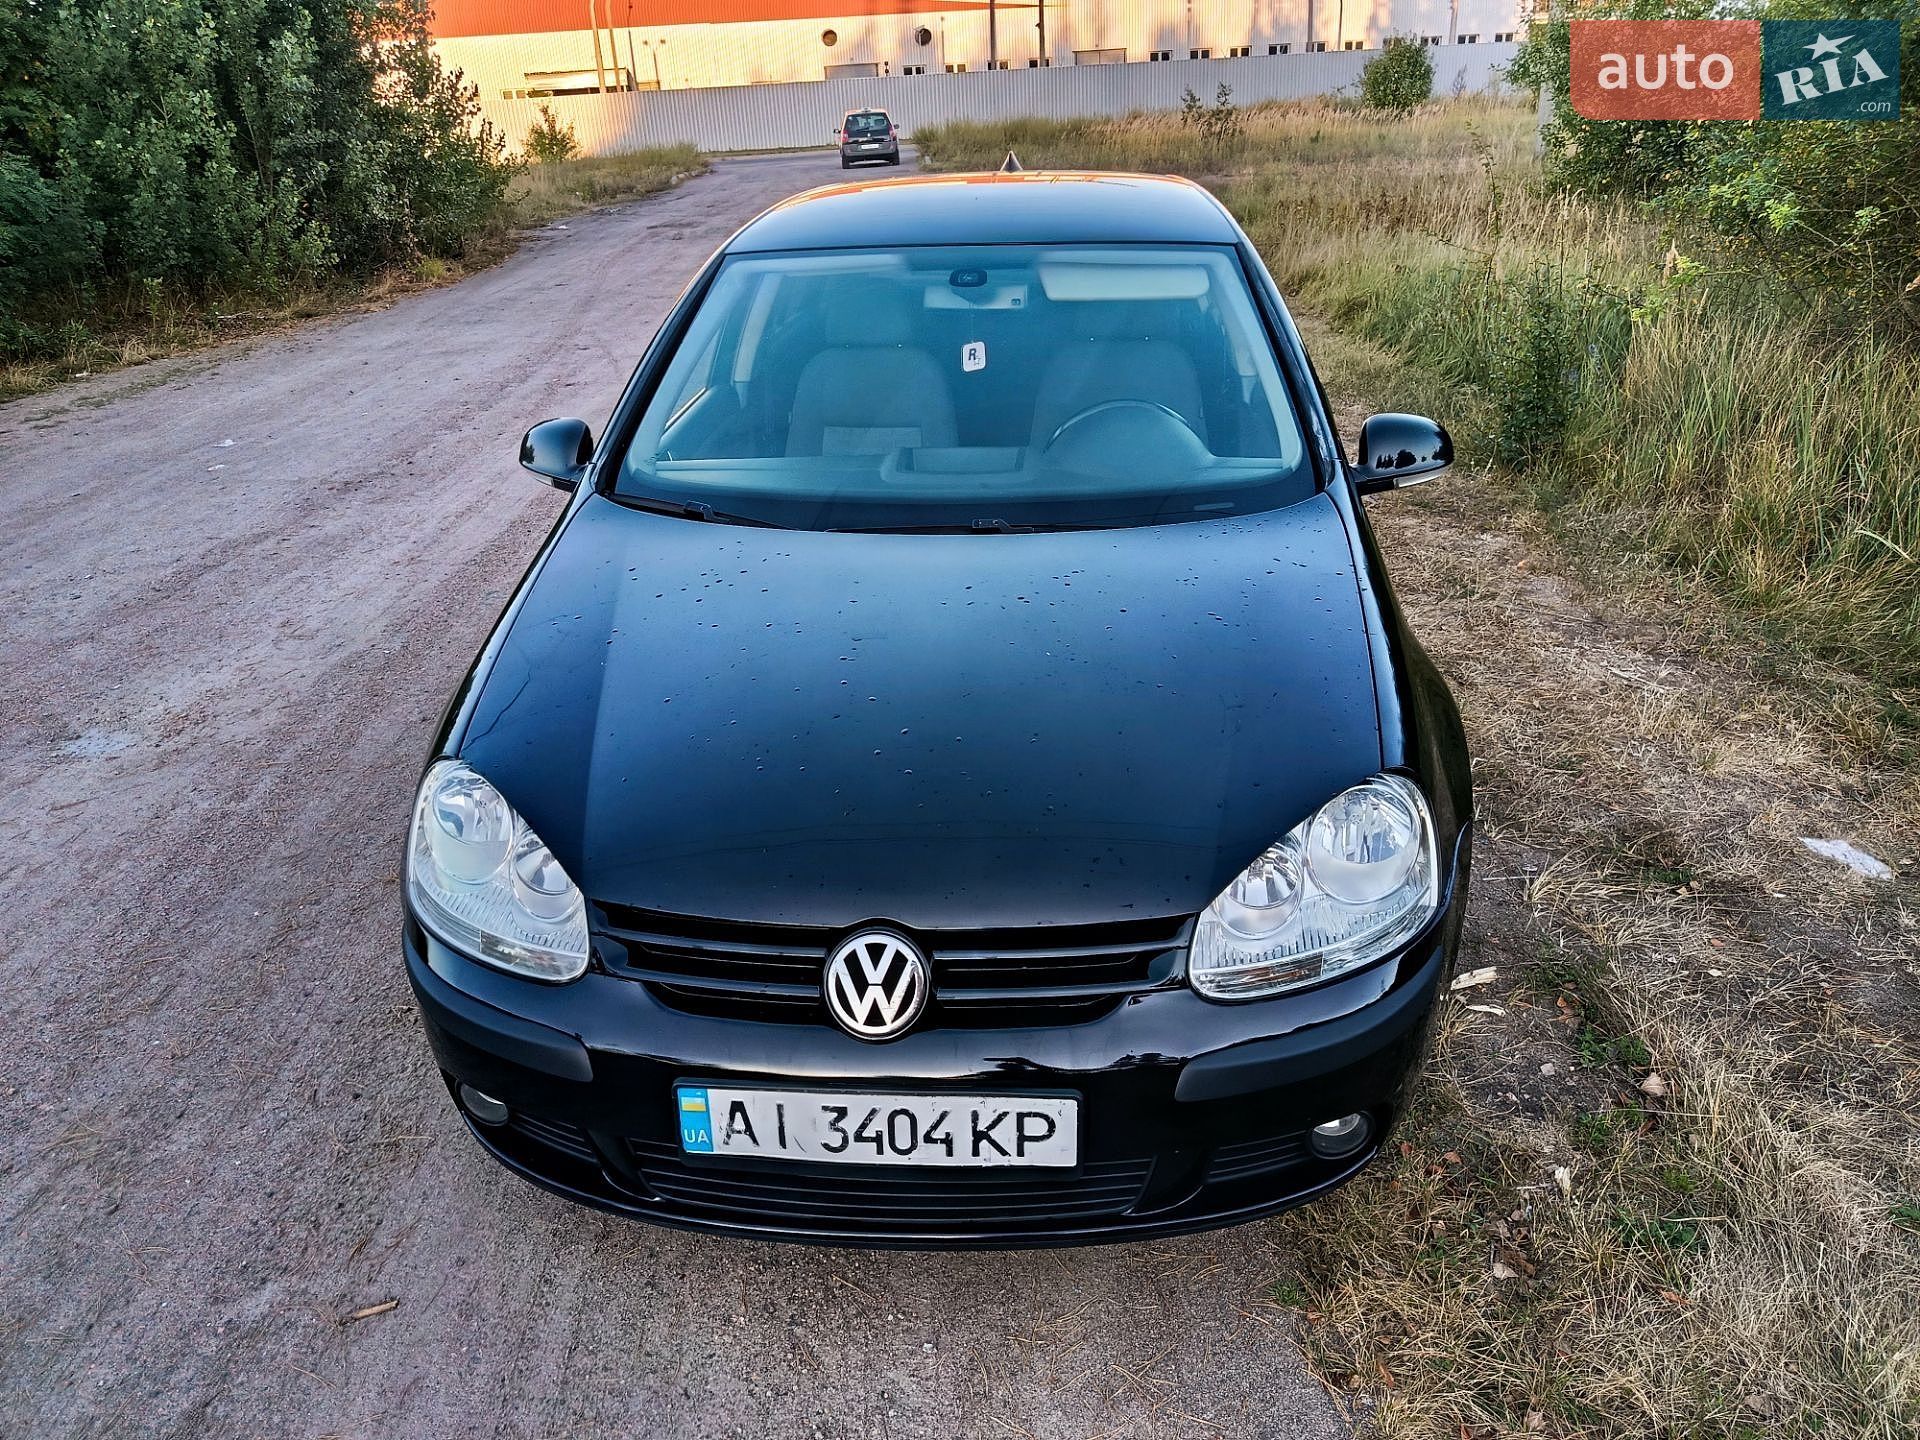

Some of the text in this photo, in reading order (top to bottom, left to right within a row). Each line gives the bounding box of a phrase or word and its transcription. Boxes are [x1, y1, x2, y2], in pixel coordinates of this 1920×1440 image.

[968, 347, 977, 361] R
[829, 934, 924, 1033] VW
[683, 1129, 710, 1144] UA
[723, 1100, 1057, 1158] AI 3404 KP
